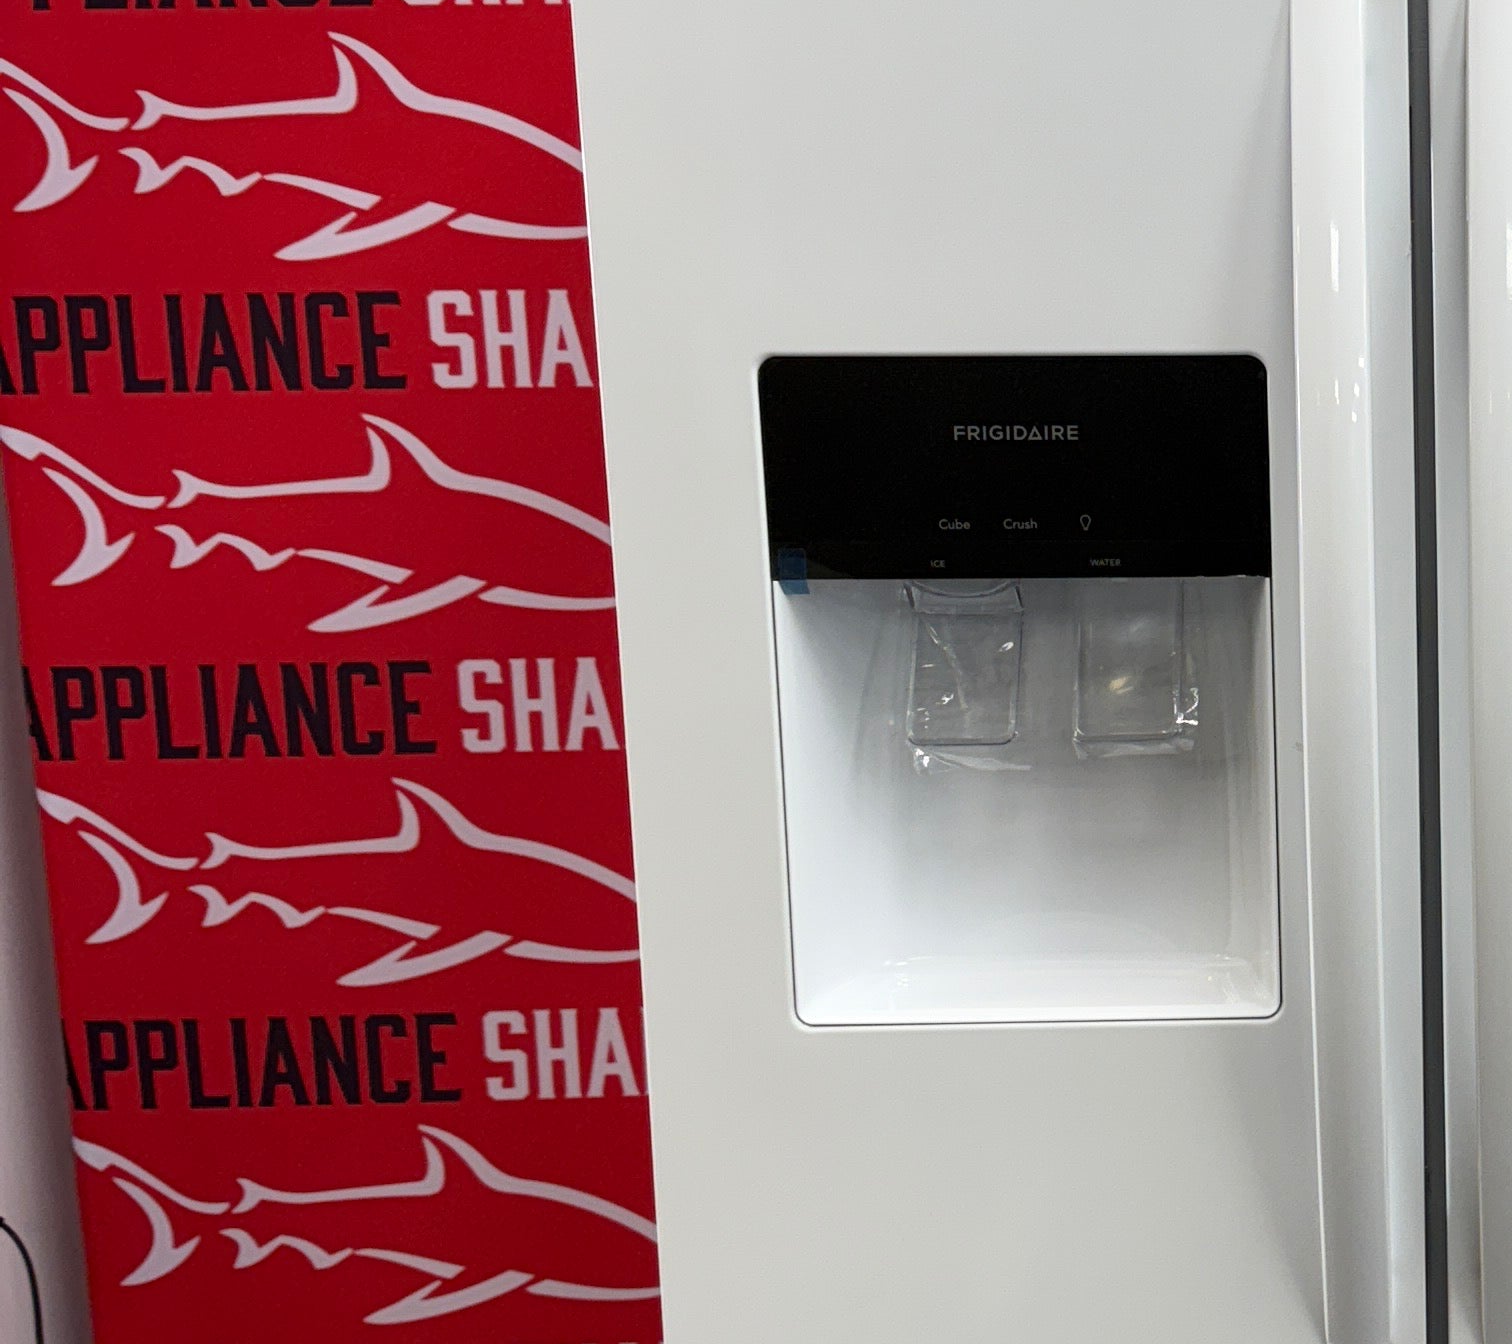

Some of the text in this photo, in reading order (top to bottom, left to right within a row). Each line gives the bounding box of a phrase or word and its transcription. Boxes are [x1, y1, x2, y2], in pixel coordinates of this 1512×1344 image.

[0, 291, 407, 395] PPLIANCE
[953, 425, 1080, 441] FRIGIDAIRE
[939, 518, 970, 530] Cube
[1003, 518, 1038, 530] Crush
[931, 559, 946, 568] ICE
[1089, 558, 1122, 567] WATER
[63, 1007, 648, 1111] PPLIANCE SHA
